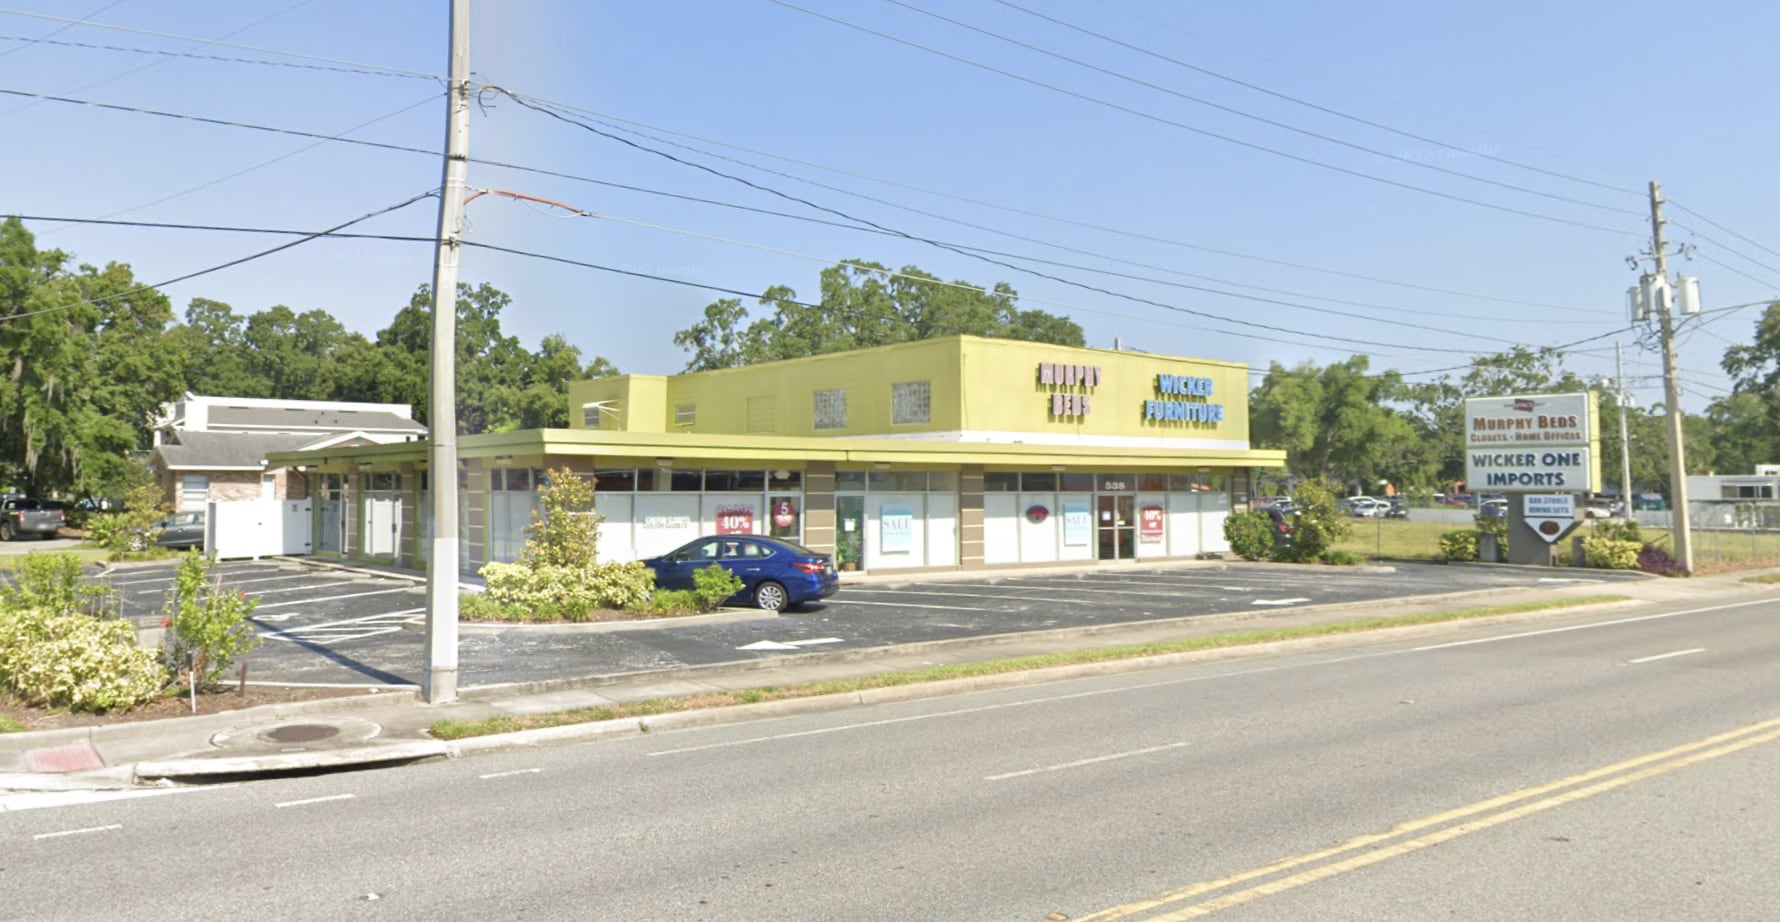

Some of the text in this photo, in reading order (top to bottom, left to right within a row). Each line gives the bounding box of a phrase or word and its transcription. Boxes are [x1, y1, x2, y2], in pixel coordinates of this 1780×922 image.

[1039, 362, 1101, 388] MURPHY
[1157, 374, 1213, 396] WICKER
[1051, 394, 1091, 416] BEDS
[1144, 400, 1224, 423] FURNITURE
[1473, 415, 1578, 431] MURPHY BEDS
[1472, 453, 1581, 467] WICKER ONE
[1105, 481, 1126, 490] 538
[1486, 472, 1565, 486] IMPORTS
[780, 502, 789, 515] 5
[720, 515, 750, 529] 40%
